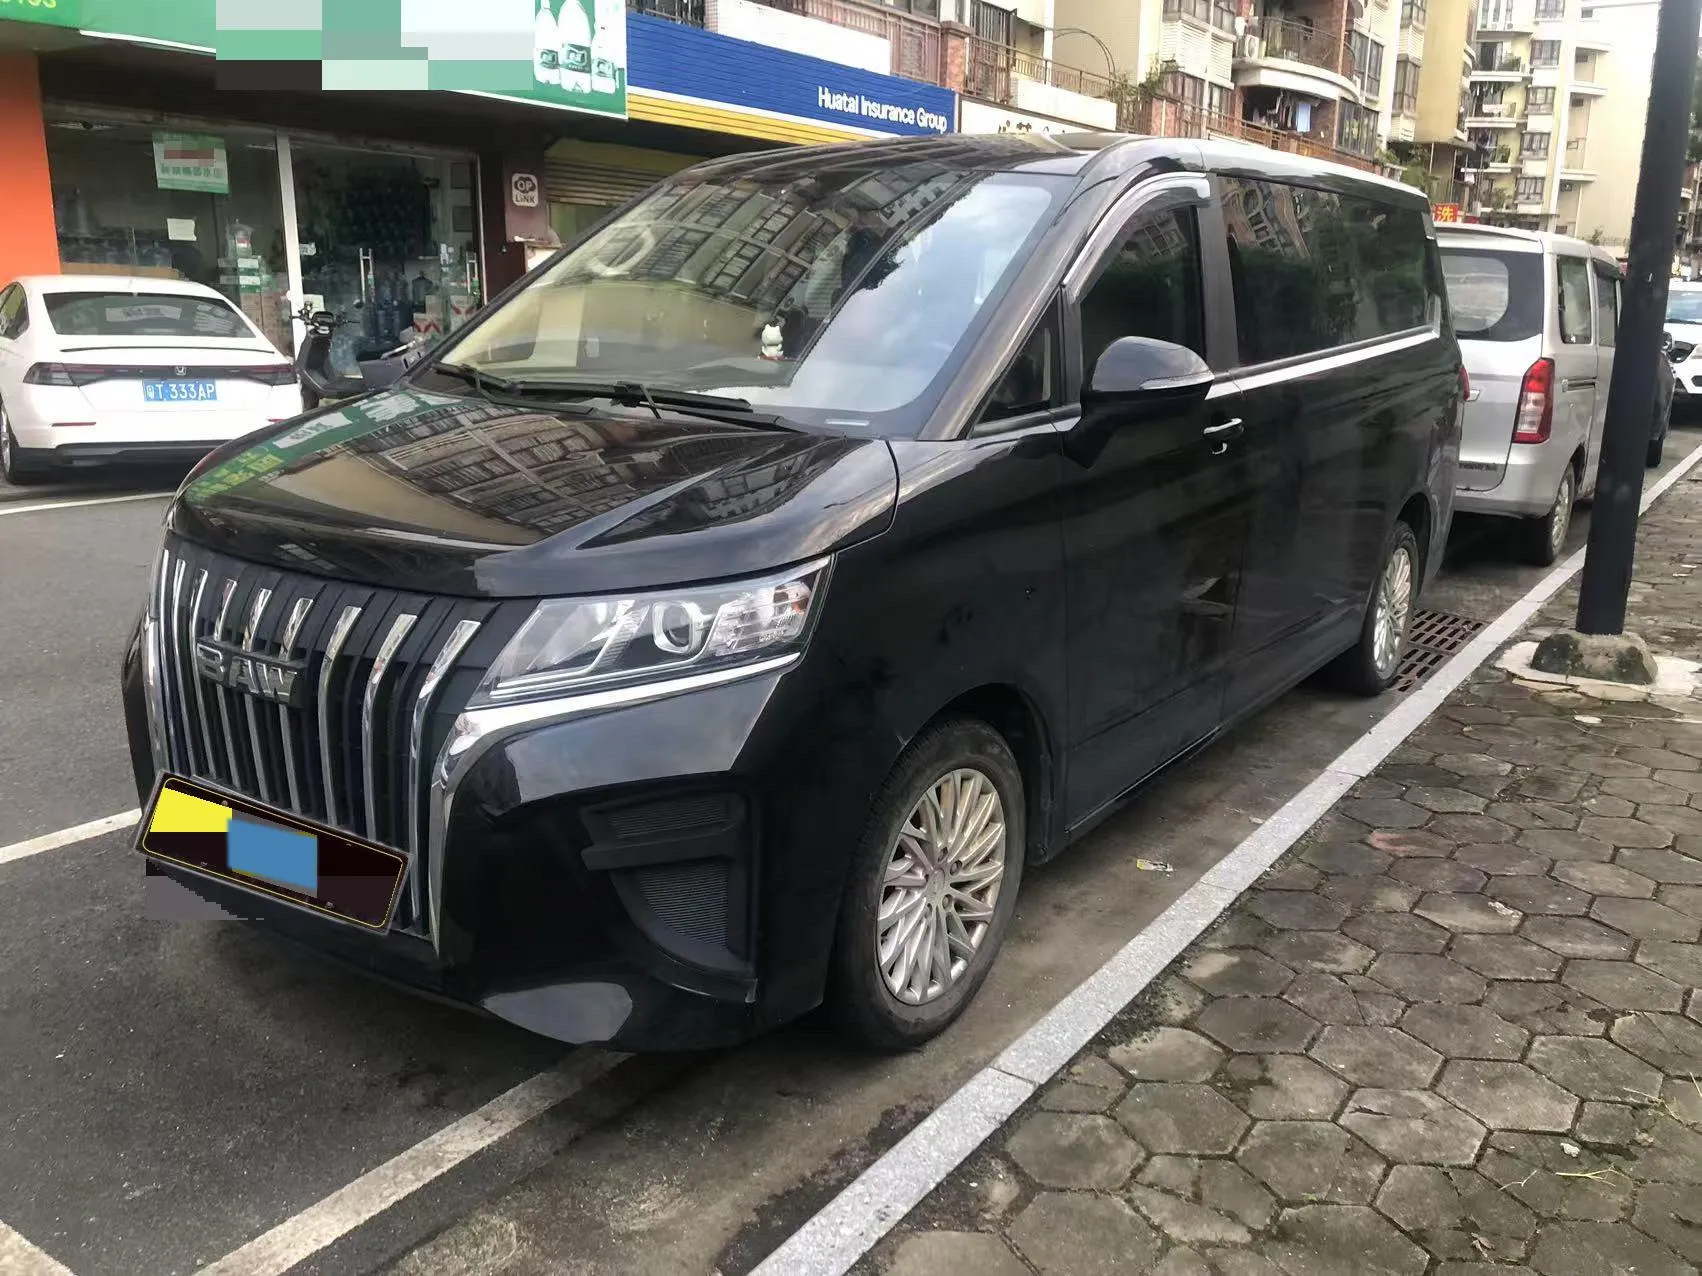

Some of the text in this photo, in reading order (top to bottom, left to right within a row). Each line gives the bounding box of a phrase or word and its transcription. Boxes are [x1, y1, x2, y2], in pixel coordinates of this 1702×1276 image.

[861, 95, 915, 125] Insurance
[916, 107, 947, 134] Group
[1436, 206, 1454, 222] 洗
[196, 642, 298, 704] BAW
